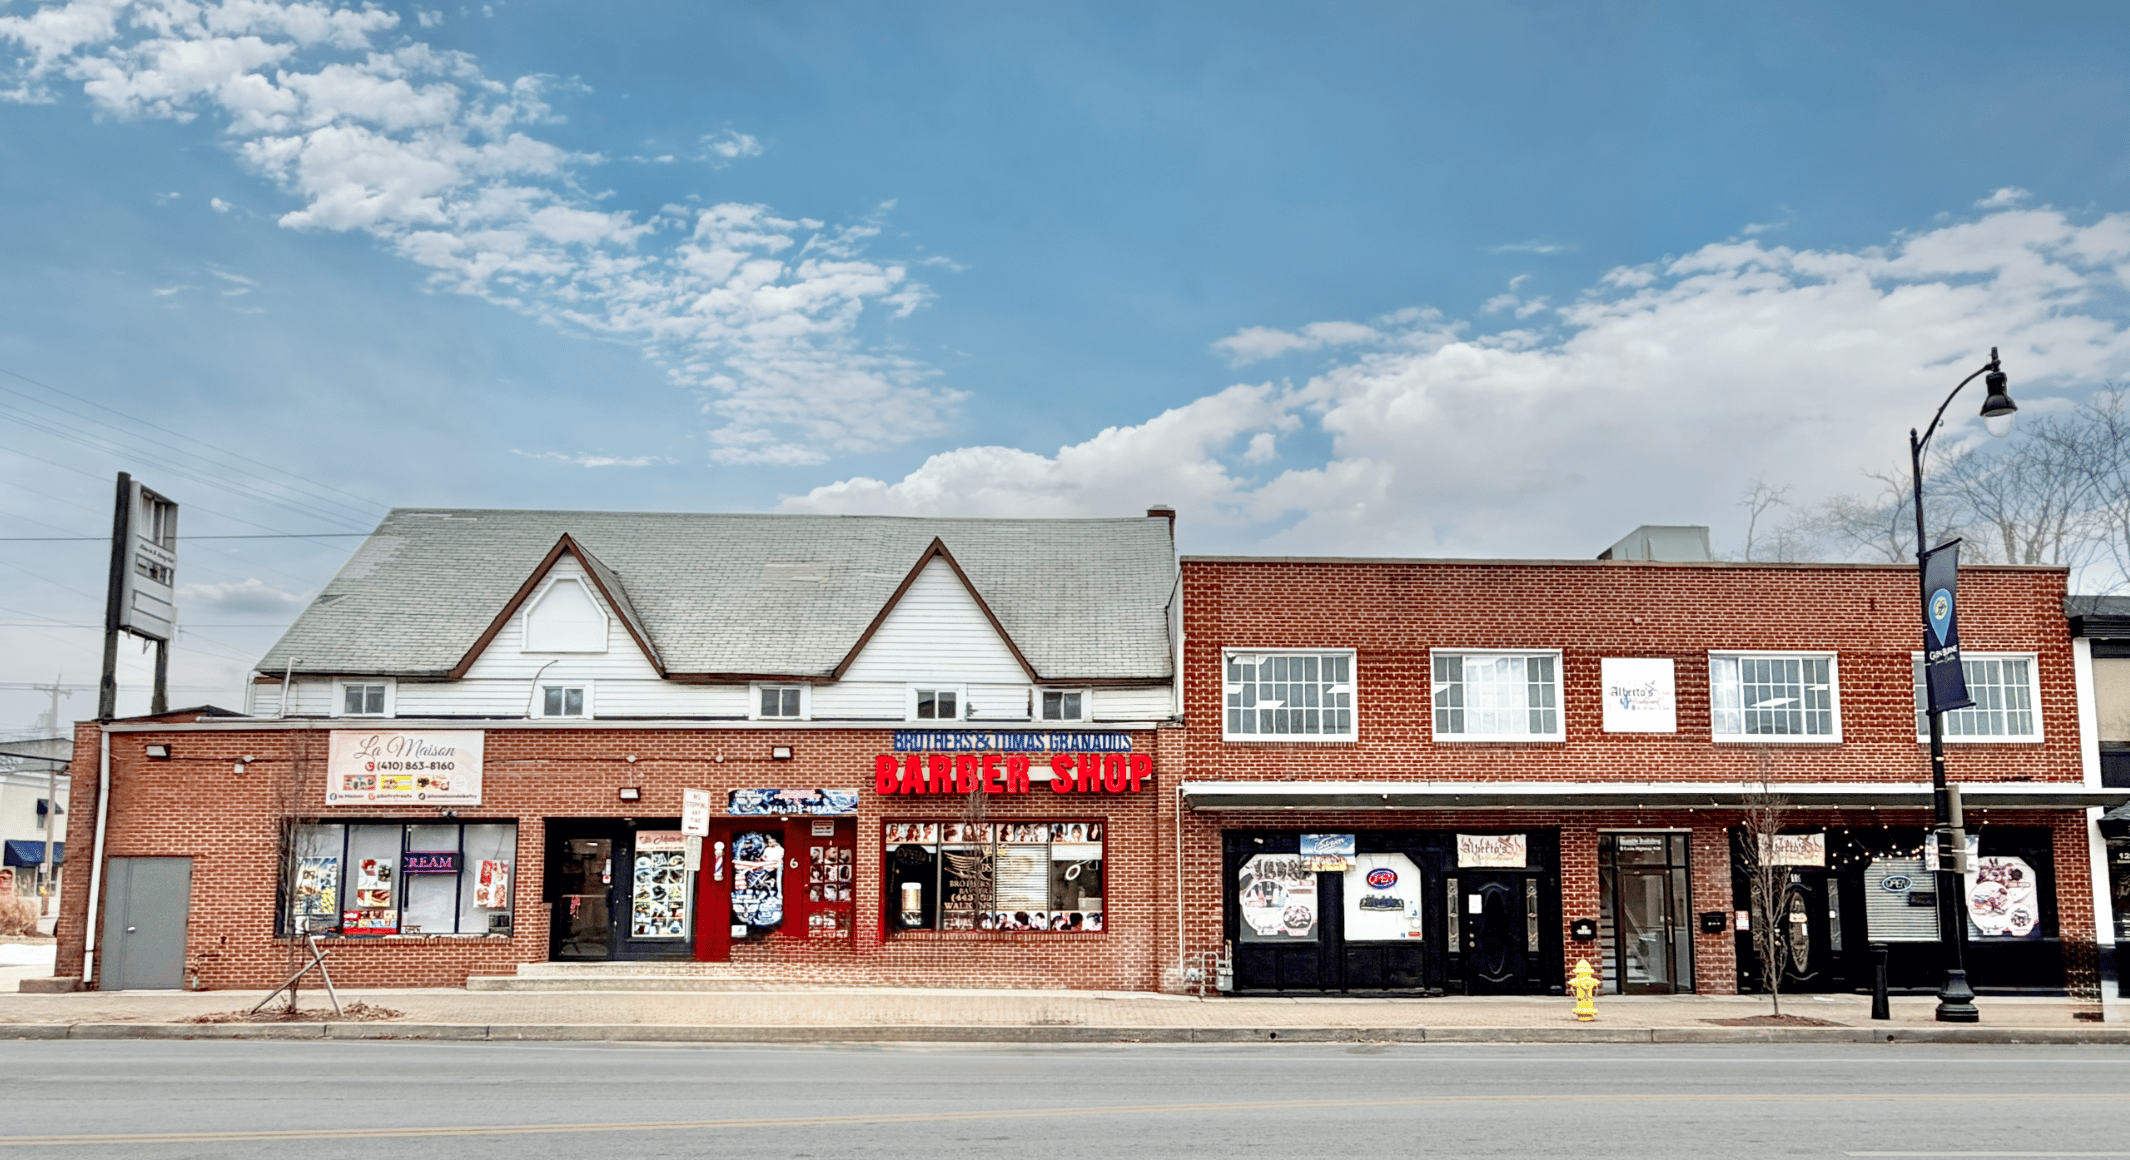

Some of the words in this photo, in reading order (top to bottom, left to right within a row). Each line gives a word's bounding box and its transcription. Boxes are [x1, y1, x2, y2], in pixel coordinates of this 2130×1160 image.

[1610, 686, 1654, 697] Alberto's
[894, 730, 976, 752] BROTHERS
[996, 731, 1045, 752] TOMAS
[1049, 731, 1132, 752] GRANADOS
[353, 735, 382, 761] La
[386, 736, 456, 758] Maison
[377, 761, 404, 771] (410)
[405, 761, 455, 771] 863-8160
[875, 754, 1031, 795] BARBER
[1050, 754, 1153, 794] SHOP
[1462, 841, 1507, 853] Alberto's
[789, 857, 798, 868] 6
[949, 880, 990, 888] BROTHRS
[1885, 878, 1910, 889] OPEN
